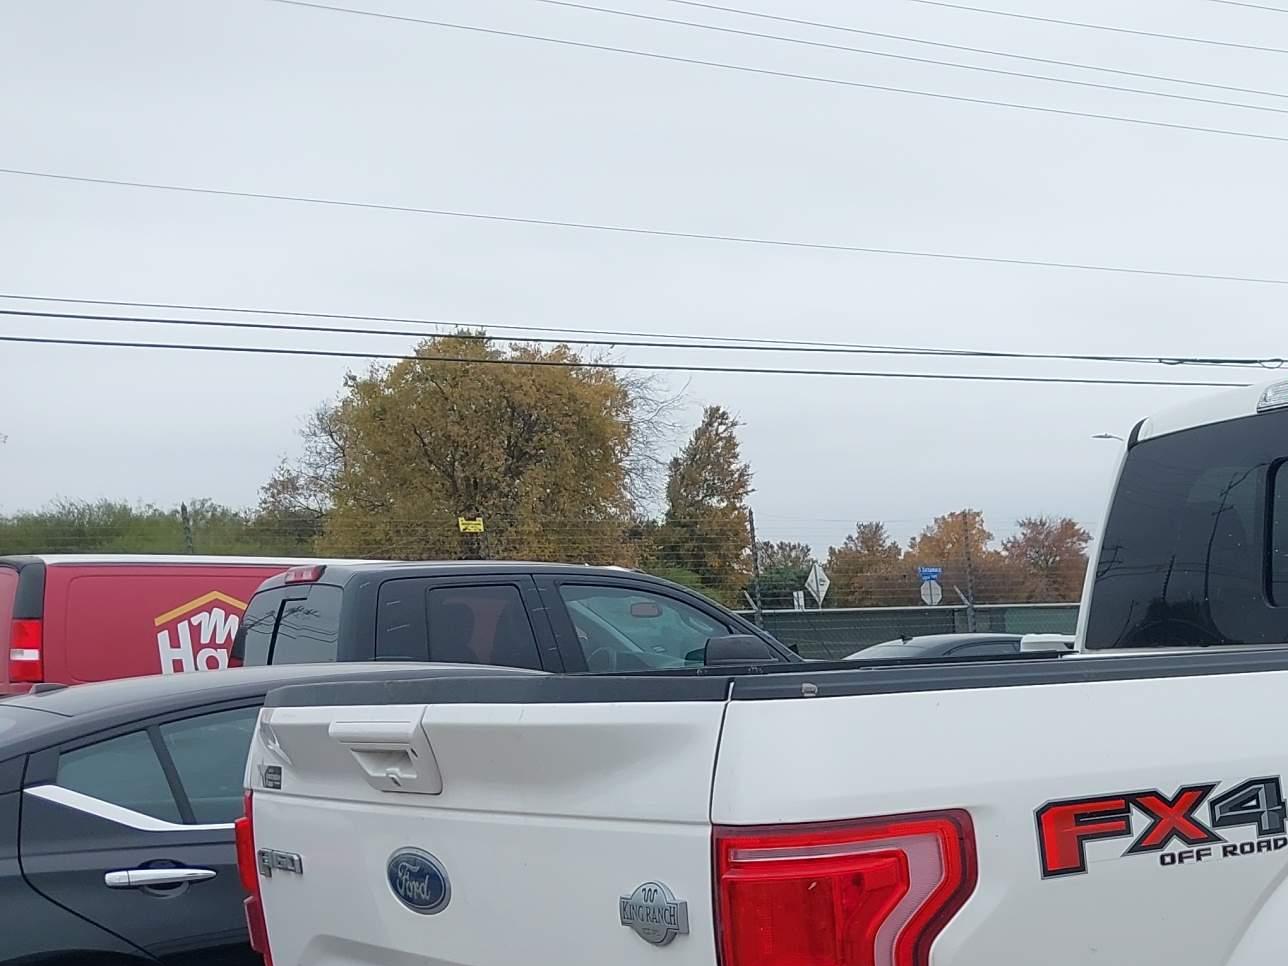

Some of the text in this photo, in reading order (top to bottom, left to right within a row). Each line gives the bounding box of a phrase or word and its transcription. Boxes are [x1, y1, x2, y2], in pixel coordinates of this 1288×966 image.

[1033, 775, 1288, 880] FX4
[1159, 836, 1288, 867] OFF ROAD
[396, 861, 431, 900] Ford
[622, 900, 677, 926] KING RANCH
